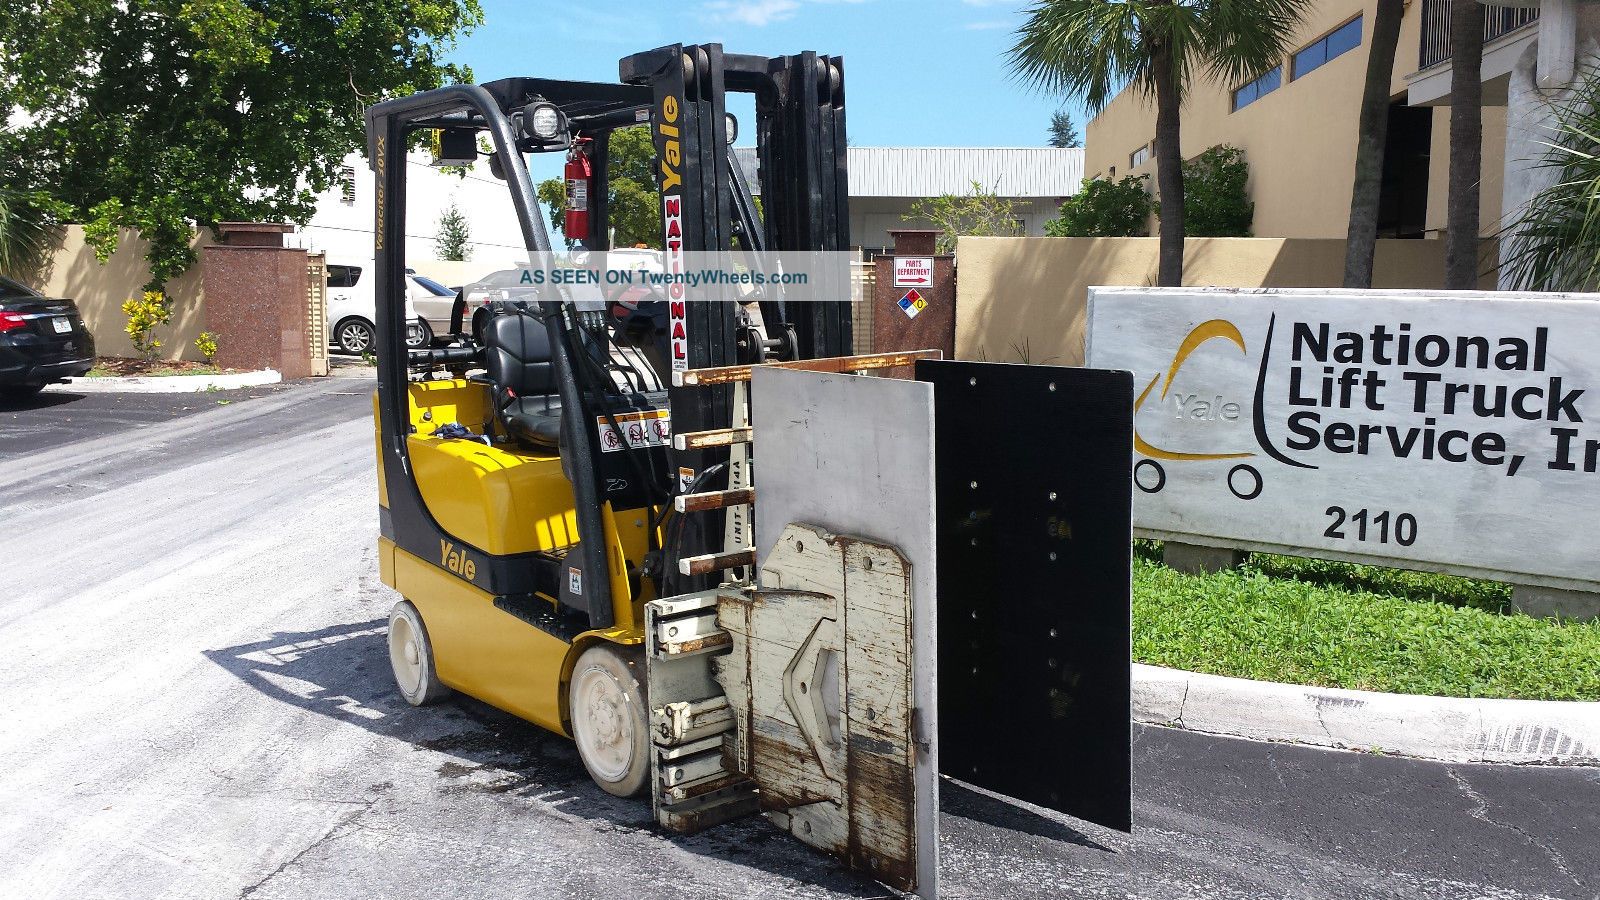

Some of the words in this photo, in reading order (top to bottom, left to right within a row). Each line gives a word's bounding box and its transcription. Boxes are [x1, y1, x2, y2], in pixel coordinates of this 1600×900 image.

[660, 94, 682, 192] Yale
[375, 181, 385, 250] Veracitor
[665, 198, 687, 361] NATIONAL
[897, 268, 930, 276] DEPARTMENT
[917, 299, 924, 309] 0
[1291, 321, 1549, 373] National
[1174, 393, 1242, 423] Yale
[1288, 366, 1387, 412] Lift
[1403, 371, 1585, 424] Truck
[1286, 410, 1526, 477] Service,
[1324, 505, 1418, 547] 2110
[440, 539, 476, 581] Yale
